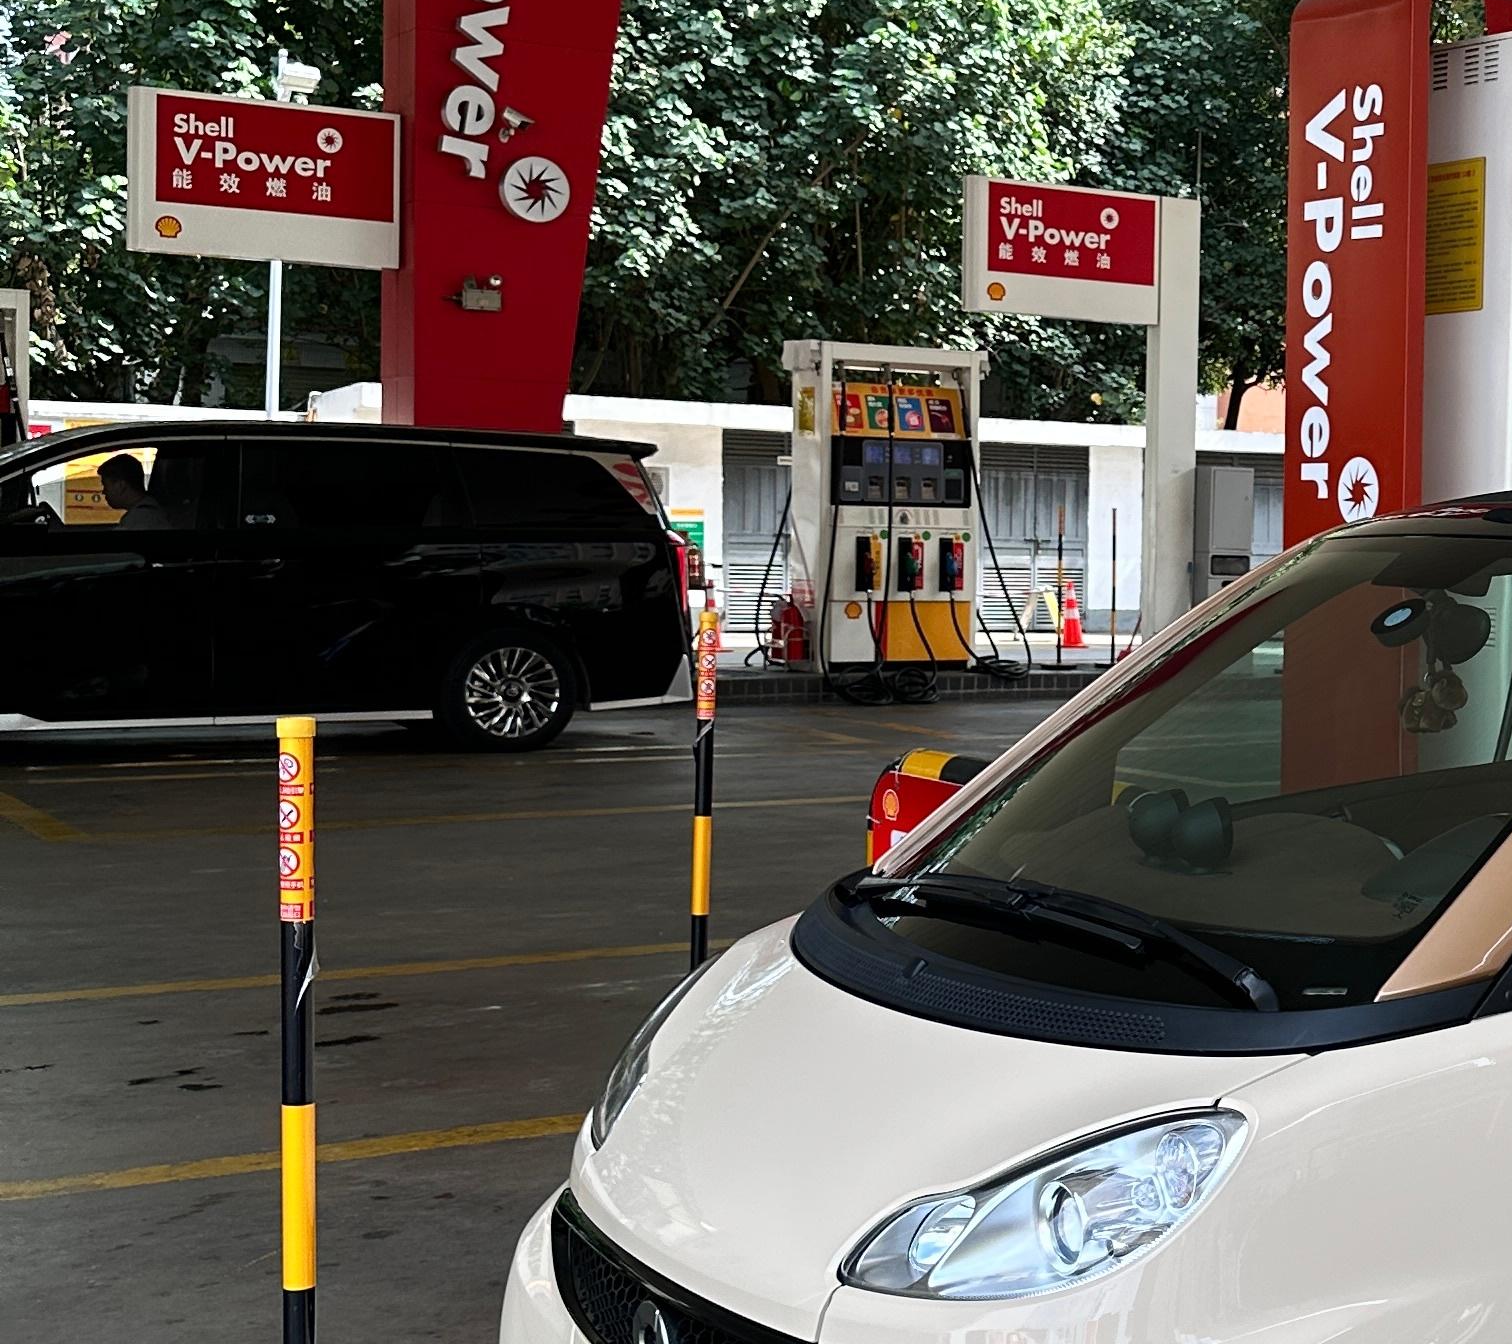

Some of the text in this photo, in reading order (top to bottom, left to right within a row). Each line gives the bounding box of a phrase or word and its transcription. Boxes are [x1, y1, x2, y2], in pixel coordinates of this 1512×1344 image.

[173, 113, 234, 138] Shell
[173, 136, 332, 178] V-Power
[1350, 83, 1385, 240] Shell
[172, 167, 332, 202] 能效燃油
[1000, 196, 1043, 217] Shell
[1000, 216, 1111, 250] V-Power
[998, 242, 1111, 269] 能效燃油
[1300, 88, 1347, 500] V-Power
